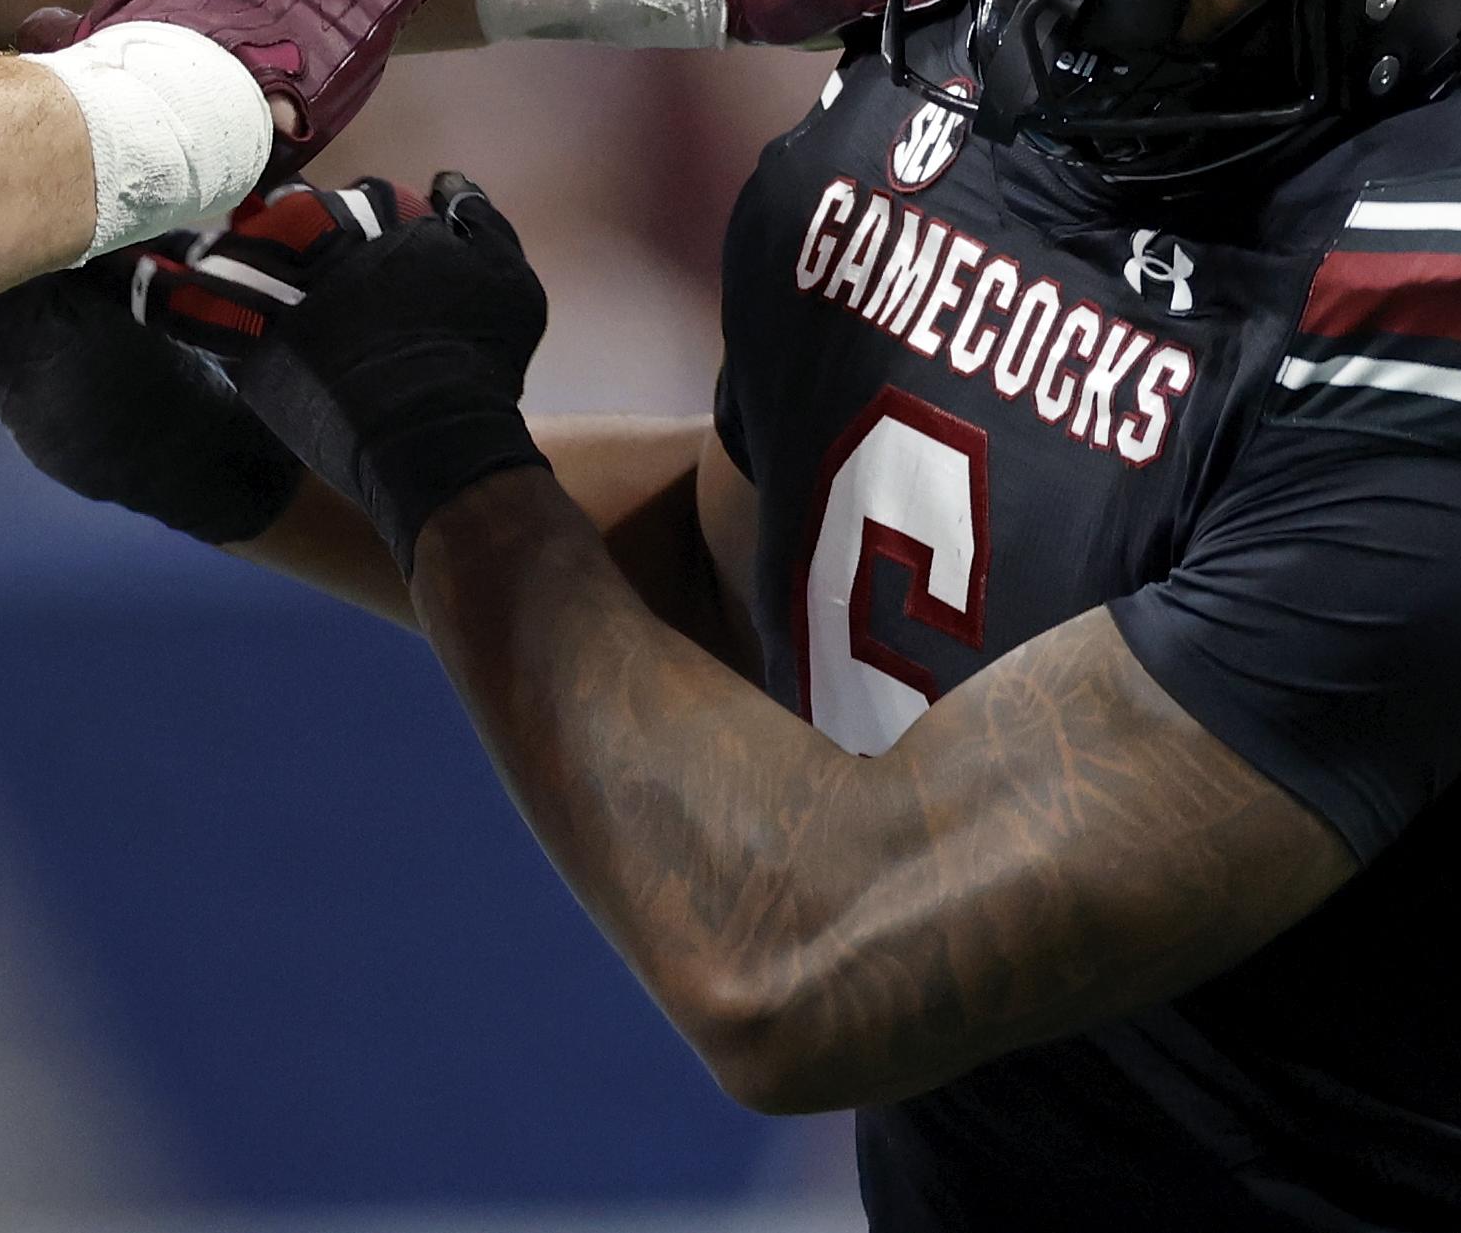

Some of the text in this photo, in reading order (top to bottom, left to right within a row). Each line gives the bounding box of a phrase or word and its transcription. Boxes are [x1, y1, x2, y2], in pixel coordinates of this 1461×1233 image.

[892, 83, 968, 184] SEC
[794, 176, 1195, 468] GAMECOCKS
[791, 383, 992, 758] 6
